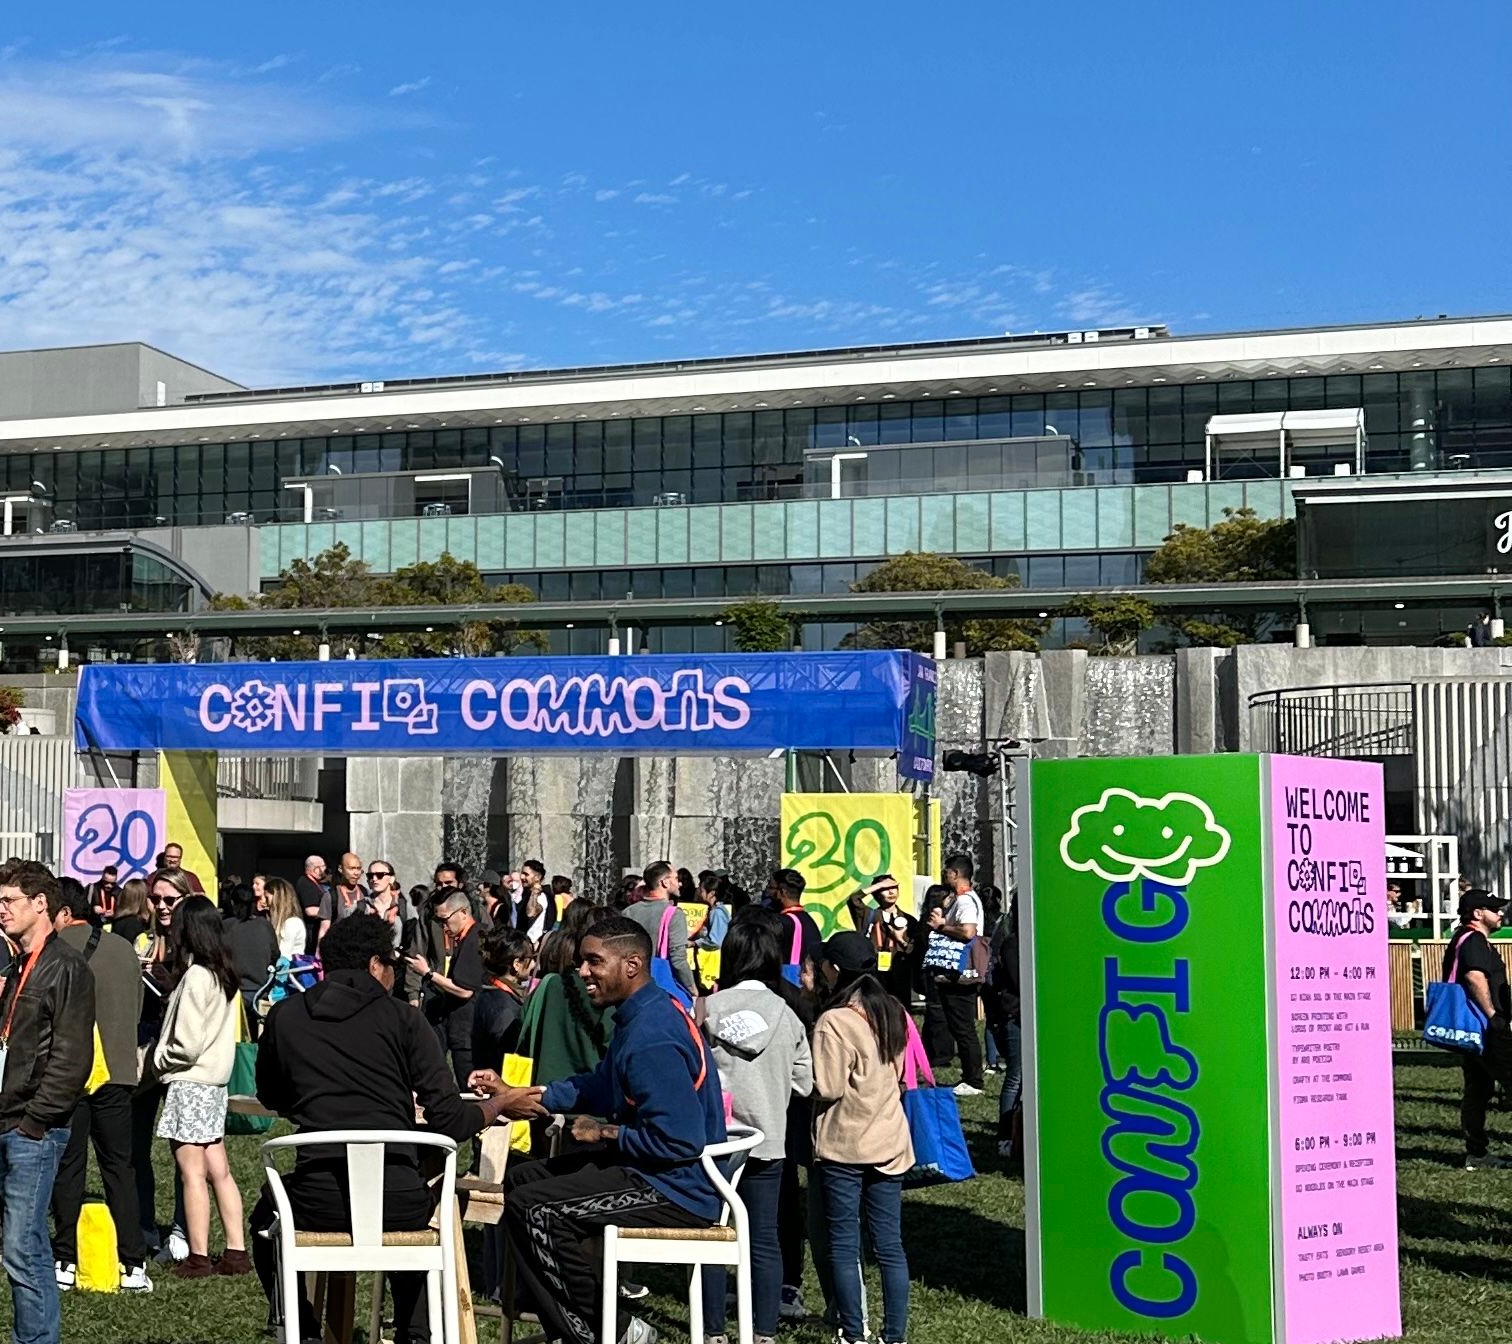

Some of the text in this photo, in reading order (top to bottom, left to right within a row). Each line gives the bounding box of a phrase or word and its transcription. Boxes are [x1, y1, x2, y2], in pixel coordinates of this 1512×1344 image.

[199, 669, 751, 737] CONFIG COMMONS
[1285, 786, 1370, 823] WELCOME
[71, 803, 156, 875] 20
[1287, 822, 1312, 856] TO
[1288, 857, 1367, 895] CONFIG
[1289, 897, 1375, 937] COMMONS
[1290, 966, 1315, 979] 12:00
[1319, 966, 1330, 979] PM
[1343, 966, 1362, 979] 4:00
[1365, 966, 1376, 979] PM
[1099, 879, 1200, 1318] CONFIG
[1295, 1136, 1315, 1151] 6:00
[1319, 1136, 1330, 1148] PM
[1343, 1133, 1362, 1147] 9:00
[1366, 1132, 1376, 1144] PM
[1297, 1222, 1343, 1240] ALWAYS ON
